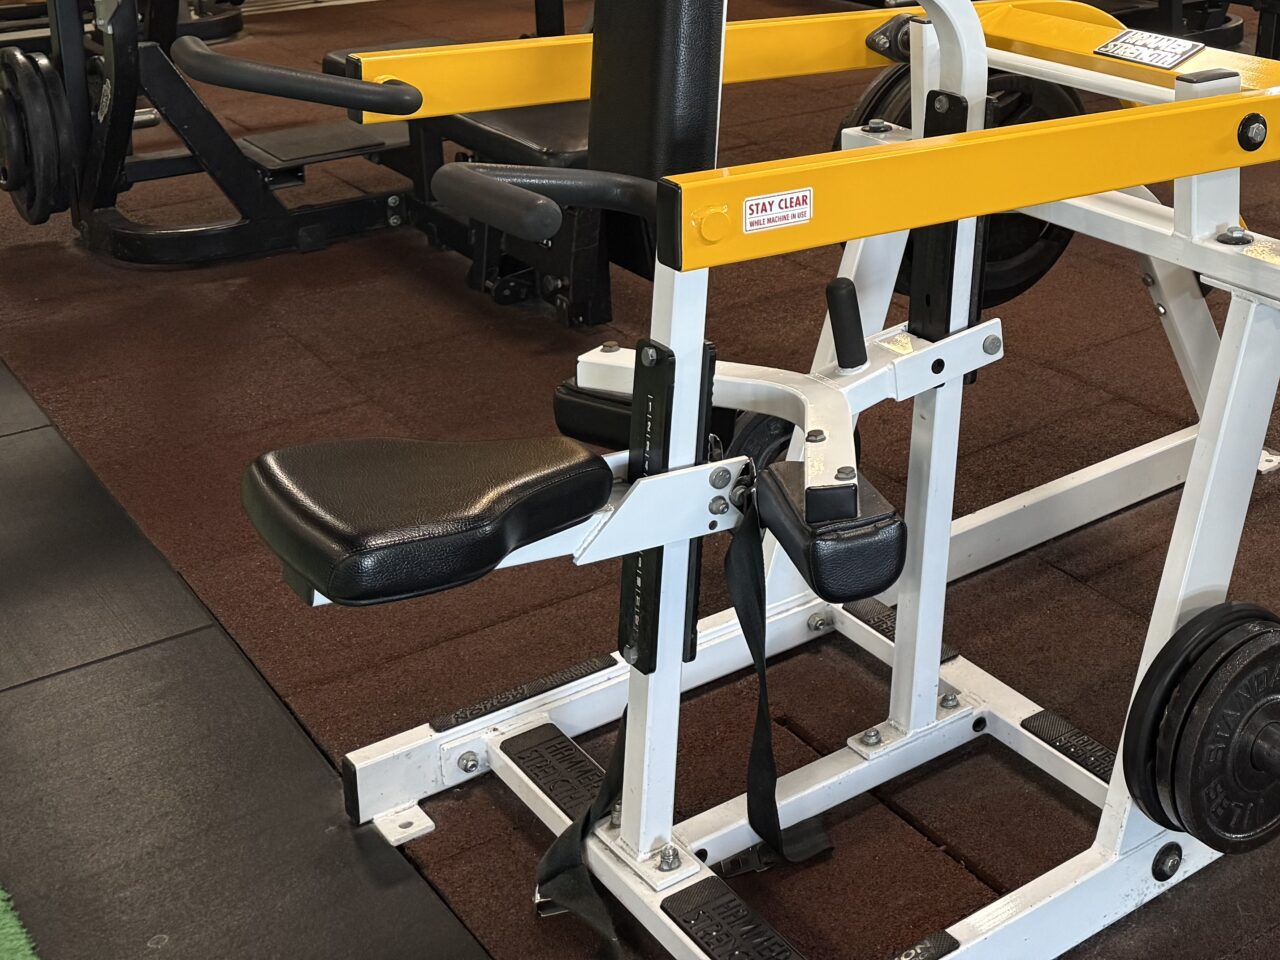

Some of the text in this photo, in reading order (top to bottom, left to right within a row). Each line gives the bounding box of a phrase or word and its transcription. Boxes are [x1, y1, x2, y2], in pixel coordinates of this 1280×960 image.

[749, 195, 808, 216] STAY CLEAR
[749, 218, 765, 227] WHILE
[767, 213, 790, 225] MACHINE
